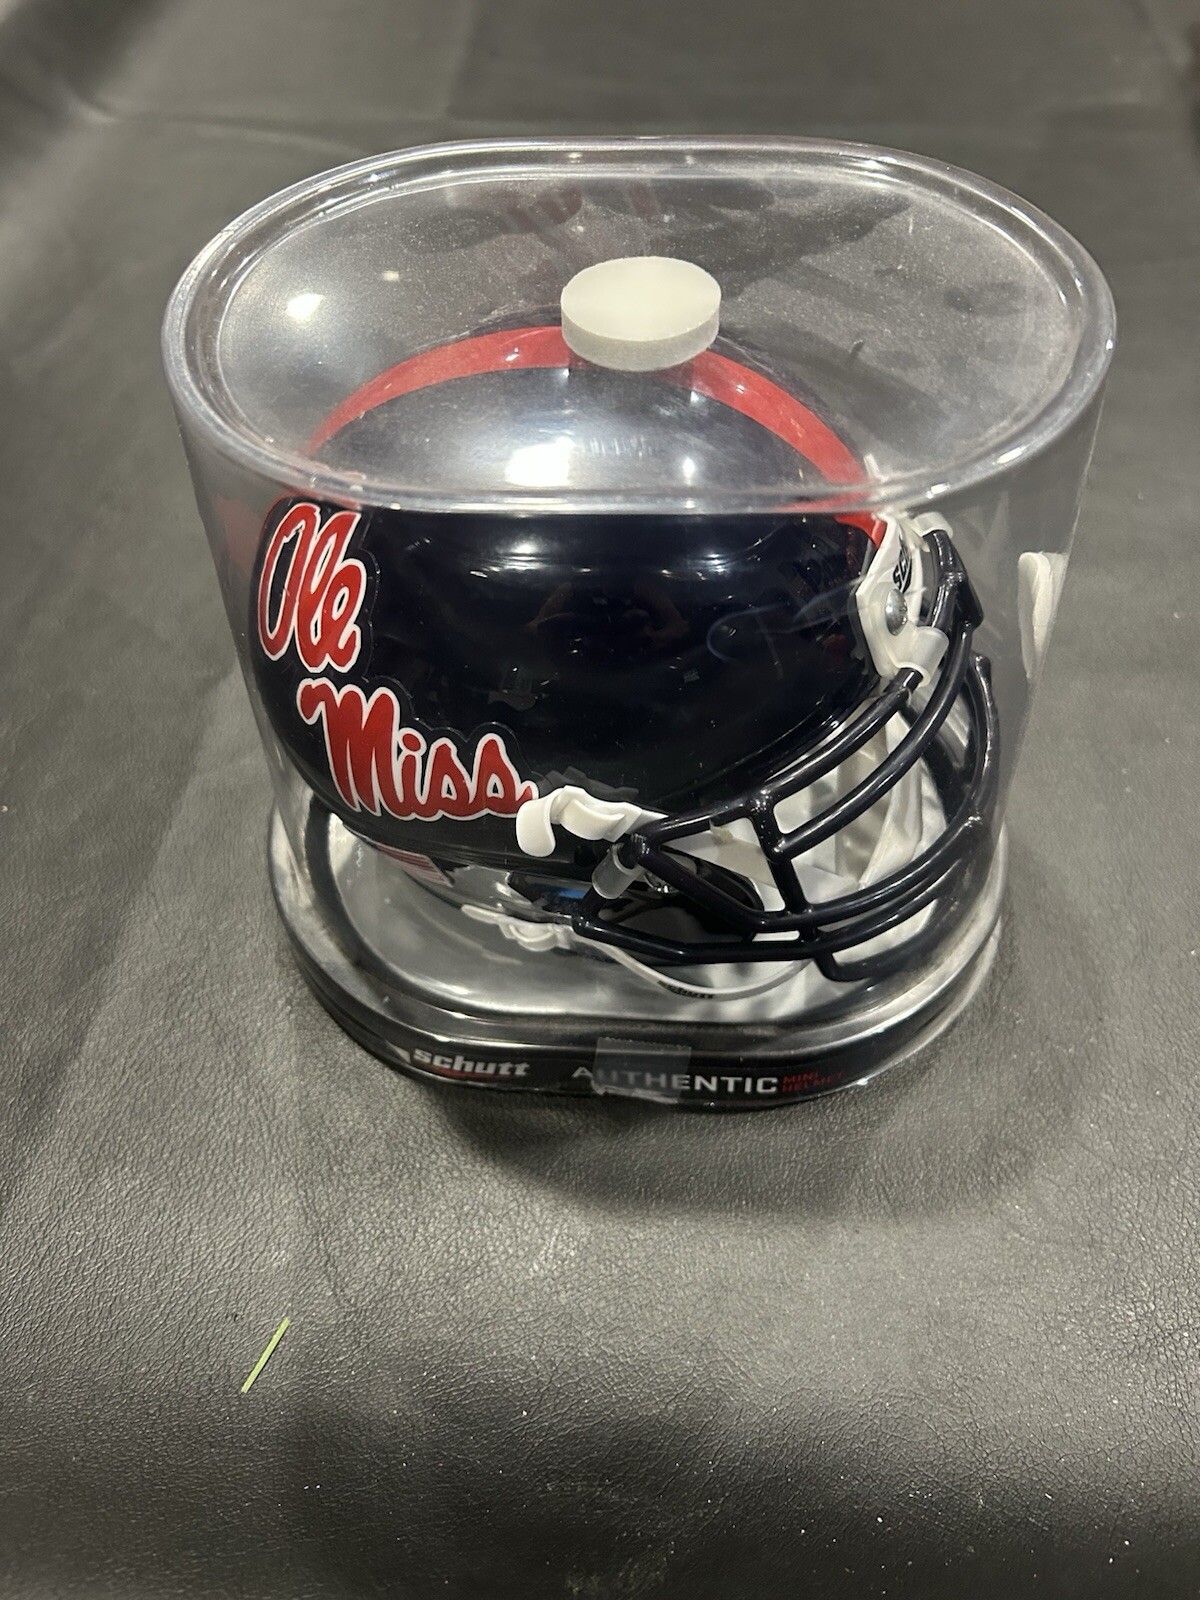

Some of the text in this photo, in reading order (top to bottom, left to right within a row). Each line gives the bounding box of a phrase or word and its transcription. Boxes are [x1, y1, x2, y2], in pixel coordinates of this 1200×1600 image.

[258, 503, 367, 673] Ole
[297, 678, 539, 821] Miss
[571, 1066, 779, 1093] AUTHENTIC
